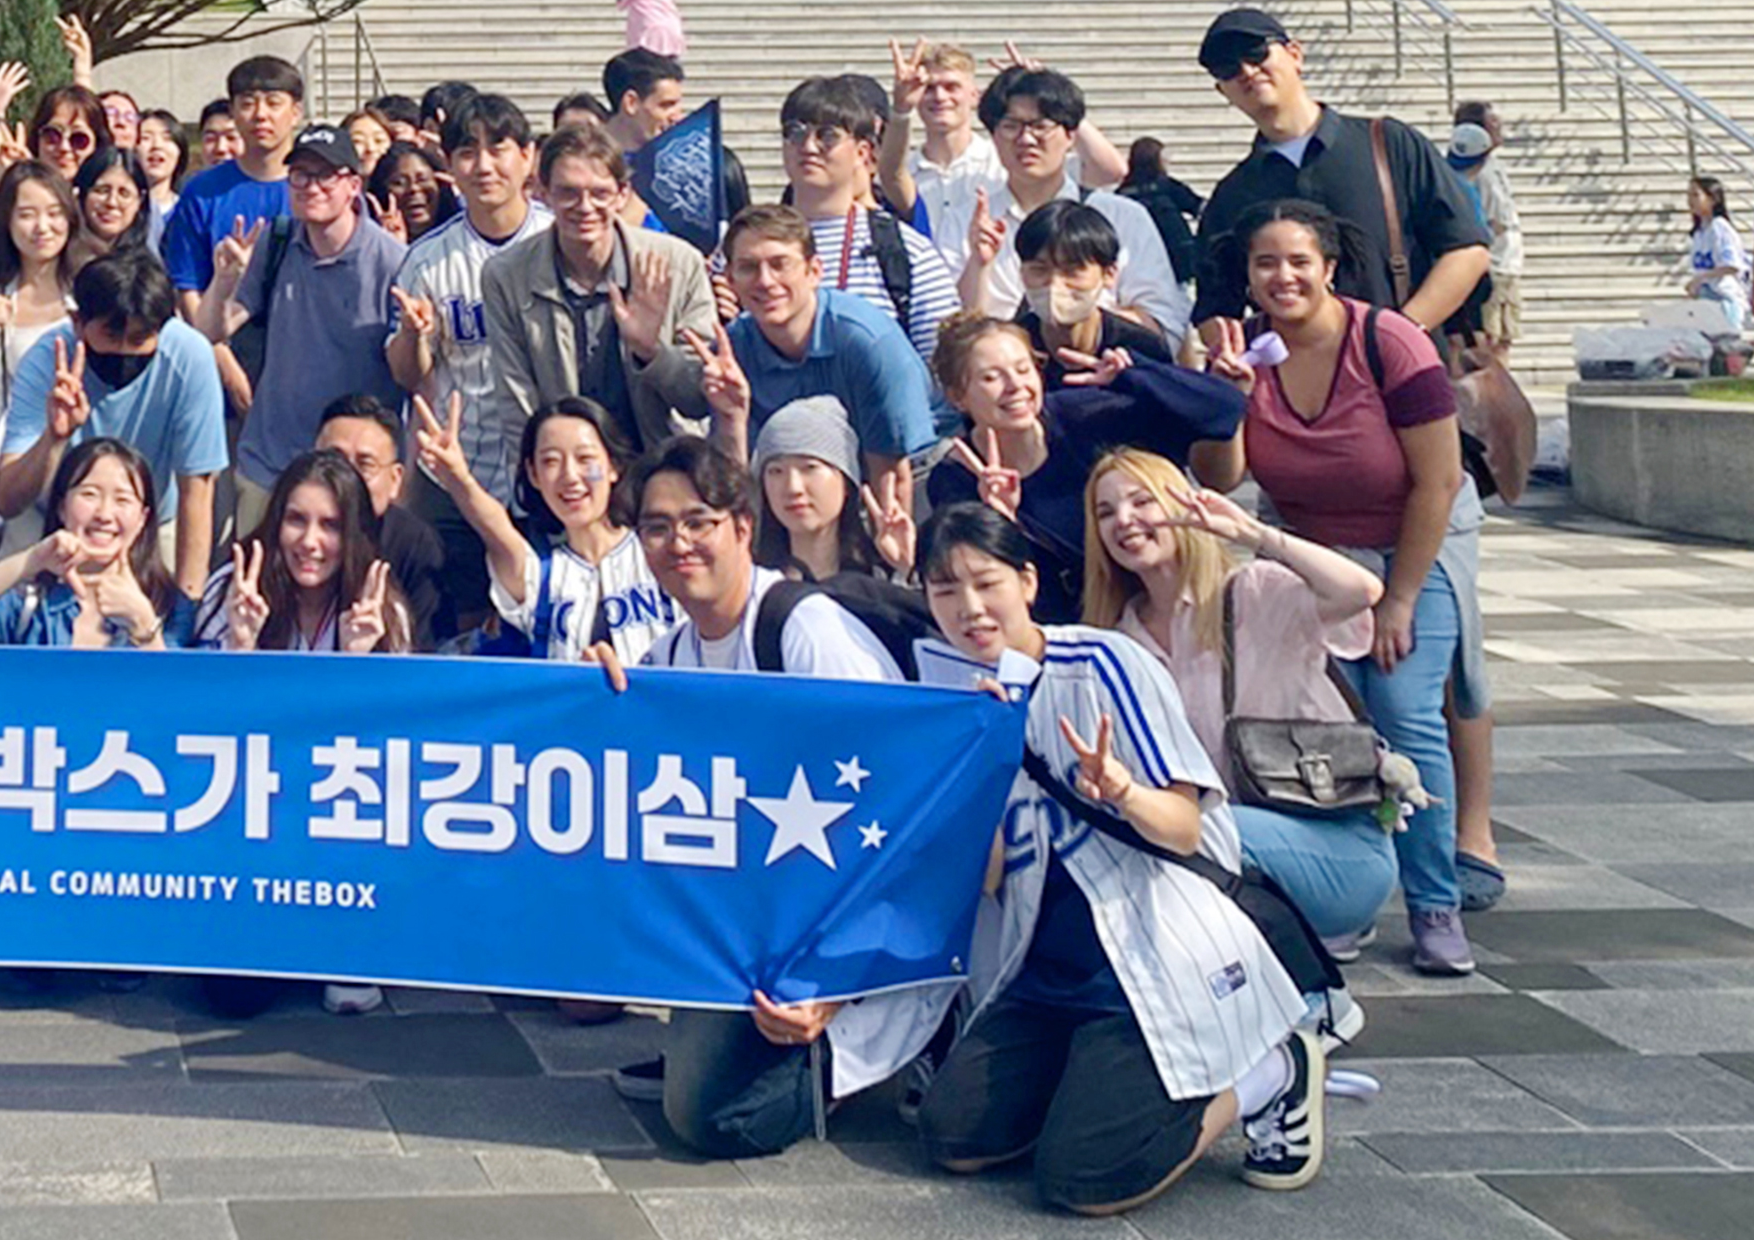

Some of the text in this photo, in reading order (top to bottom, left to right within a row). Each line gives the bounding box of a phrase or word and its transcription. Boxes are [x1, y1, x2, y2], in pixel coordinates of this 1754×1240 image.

[308, 738, 746, 868] 최강이삼
[51, 870, 238, 901] COMMUNITY
[253, 878, 376, 908] THEBOX
